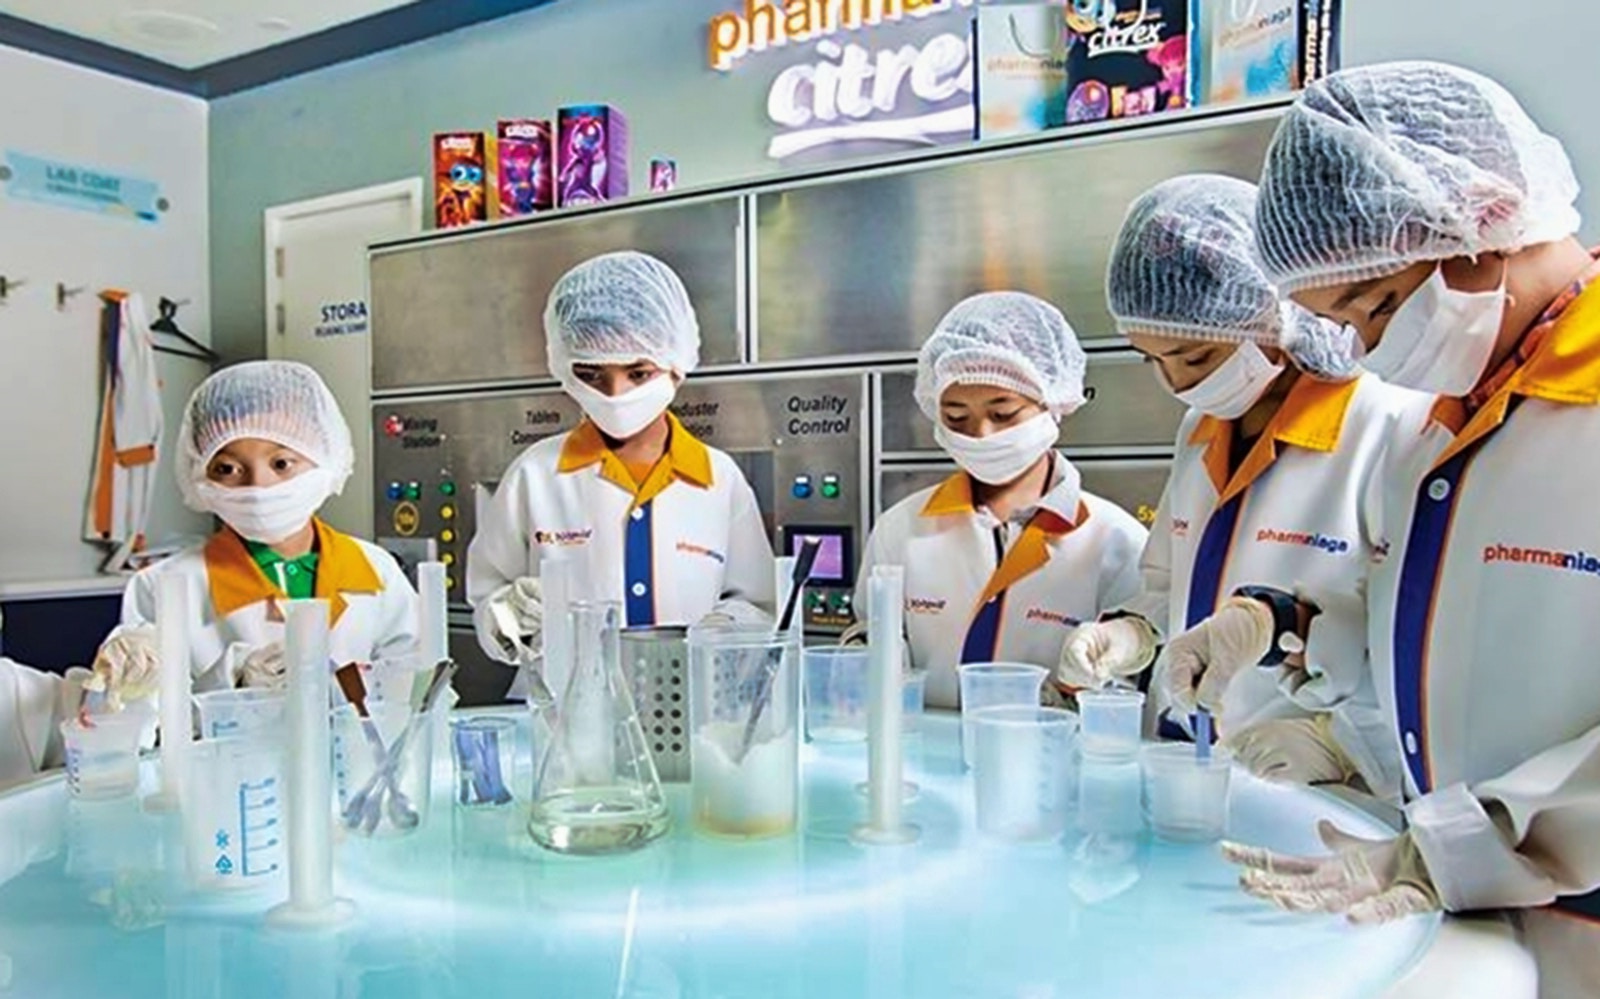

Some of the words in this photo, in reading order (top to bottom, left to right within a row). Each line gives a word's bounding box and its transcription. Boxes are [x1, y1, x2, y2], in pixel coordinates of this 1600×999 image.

[768, 33, 974, 127] citre
[787, 396, 848, 414] Quality
[788, 417, 851, 435] Control
[1256, 528, 1349, 553] pharmaniaga
[1483, 542, 1600, 577] pharmania
